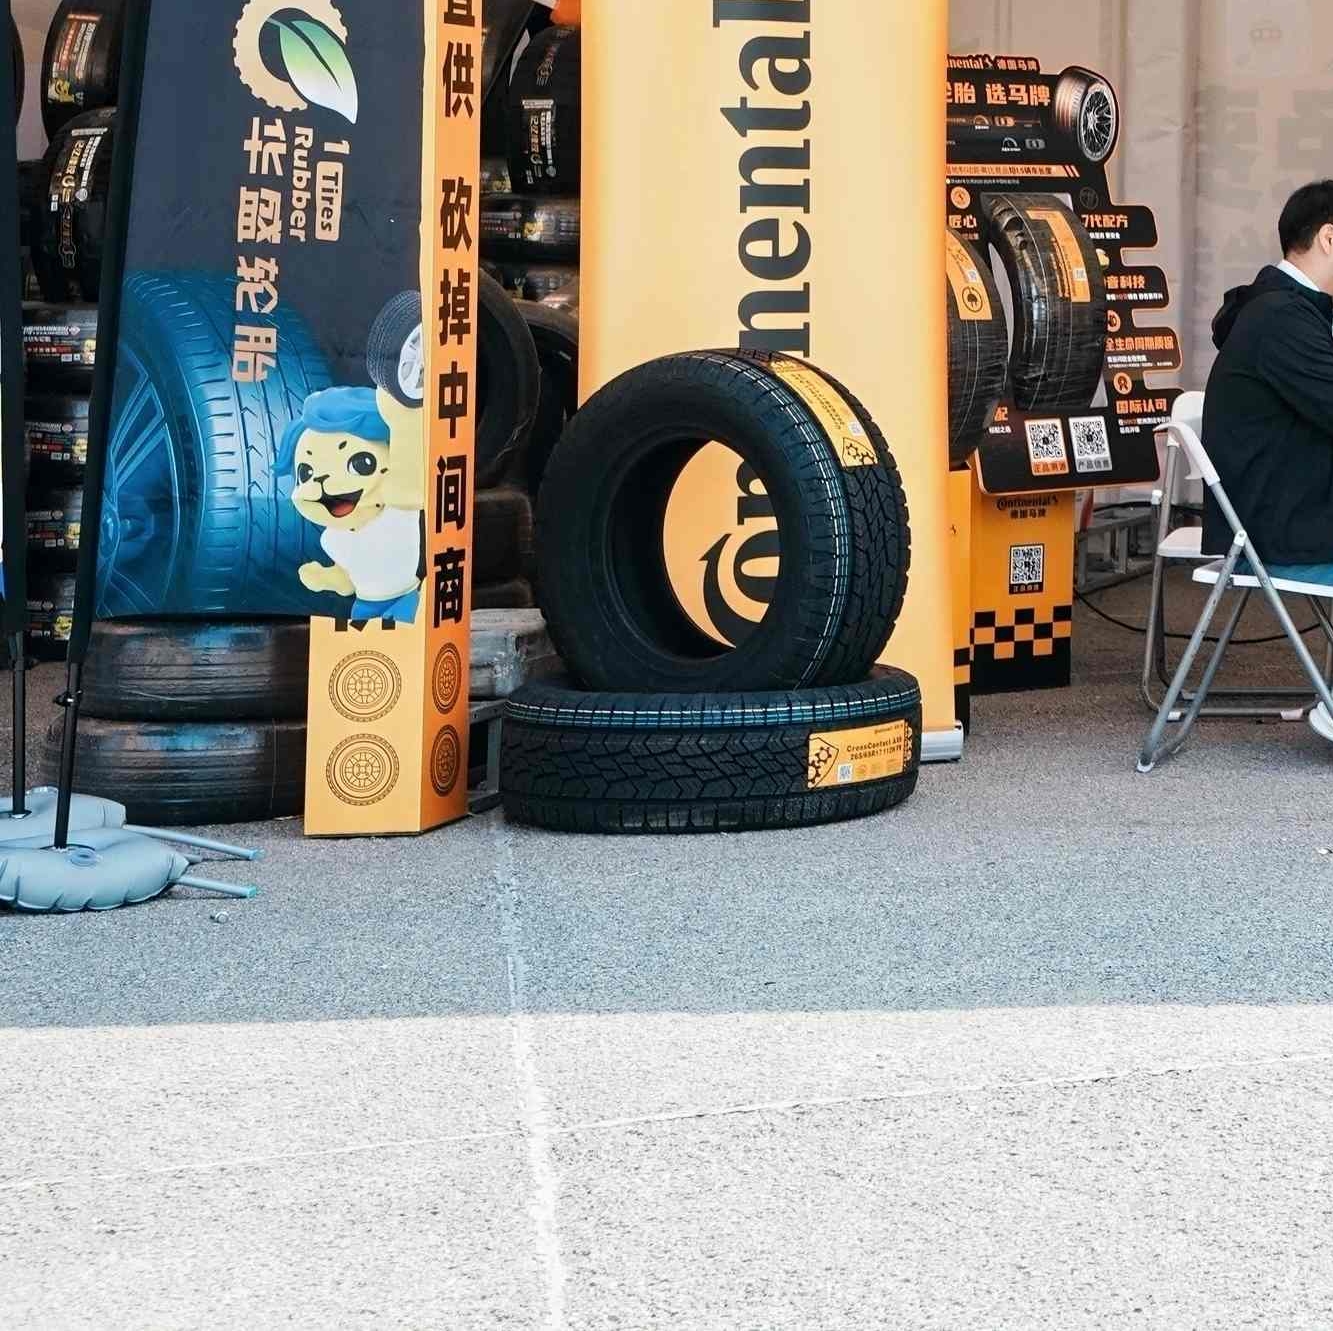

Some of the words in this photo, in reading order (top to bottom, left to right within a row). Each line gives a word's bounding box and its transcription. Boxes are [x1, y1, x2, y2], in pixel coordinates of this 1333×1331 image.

[985, 82, 1051, 106] 选马牌
[323, 139, 350, 156] 1
[288, 126, 314, 242] Rubber
[319, 168, 340, 233] Tires
[229, 116, 287, 384] 华盛轮胎
[1104, 275, 1146, 289] 音科技
[431, 177, 473, 630] 砍掉中间商
[1115, 398, 1167, 414] 国际认可
